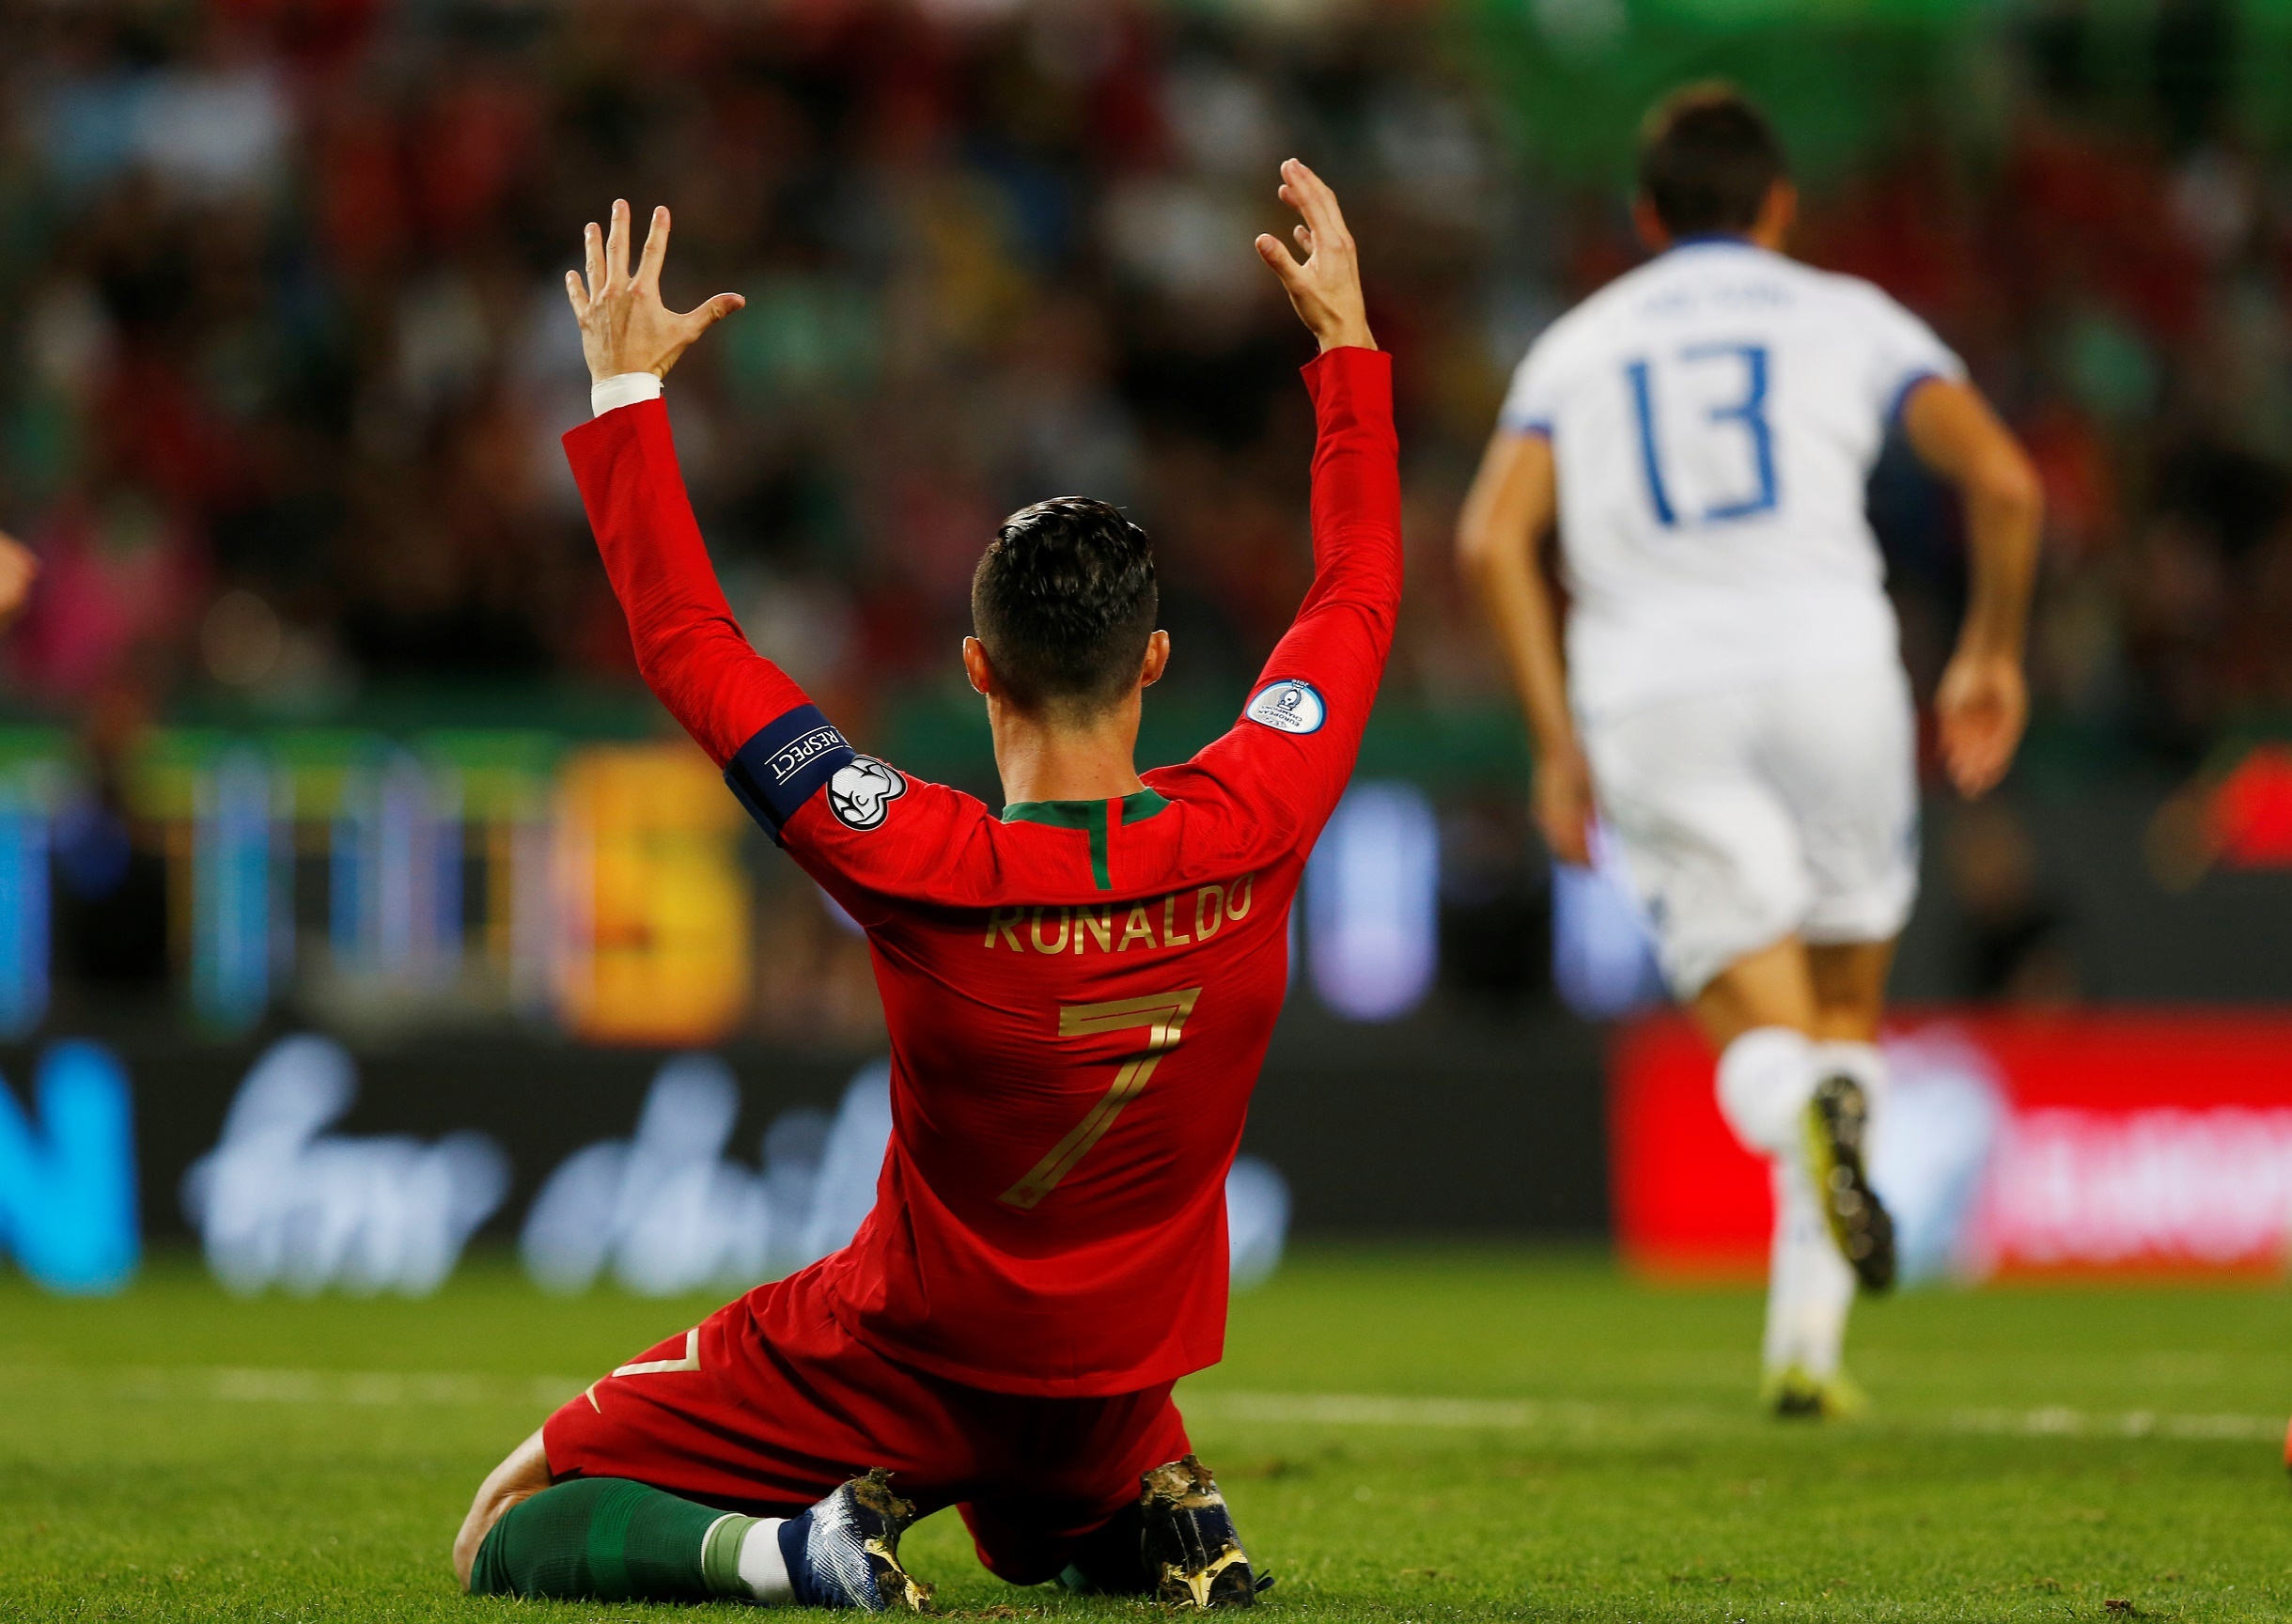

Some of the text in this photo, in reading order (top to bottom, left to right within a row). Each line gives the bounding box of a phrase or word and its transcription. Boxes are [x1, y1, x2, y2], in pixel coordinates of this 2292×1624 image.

[1624, 341, 1777, 526] 13
[772, 730, 840, 780] RESPECT
[1257, 710, 1300, 726] EUROPEAN
[984, 872, 1256, 955] RONALDO
[997, 987, 1204, 1210] 7
